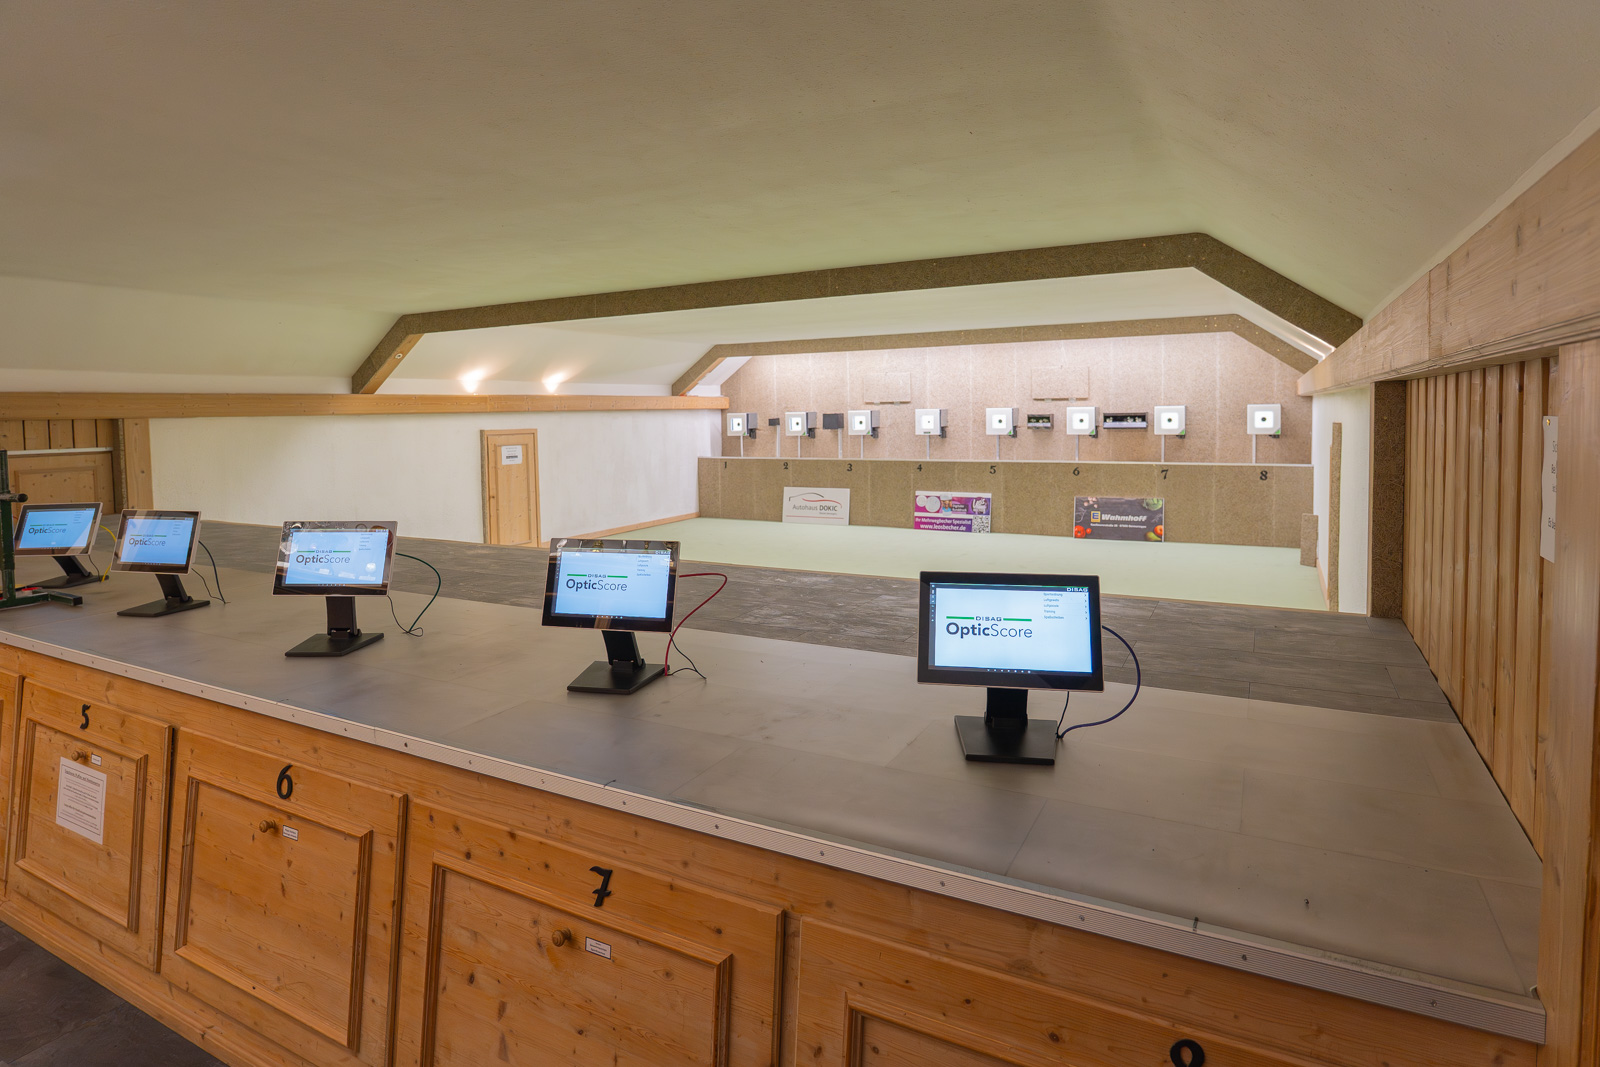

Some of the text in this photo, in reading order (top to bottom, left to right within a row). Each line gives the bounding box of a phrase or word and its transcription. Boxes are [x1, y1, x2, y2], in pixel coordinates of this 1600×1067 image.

[724, 461, 728, 470] 1
[783, 462, 789, 470] 2
[846, 463, 853, 472] 3
[916, 464, 922, 472] 4
[990, 465, 996, 474] 5
[1072, 467, 1080, 476] 6
[1160, 469, 1169, 480] 7
[1260, 470, 1268, 481] 8
[1102, 514, 1148, 522] Wahmhoff
[28, 527, 66, 535] OpticScore
[129, 537, 166, 547] OpticScore
[296, 554, 350, 565] OpticScore
[566, 578, 628, 592] OpticScore
[946, 622, 1033, 638] OpticScore
[80, 704, 91, 730] 5
[276, 764, 294, 800] 6
[589, 866, 613, 908] 7
